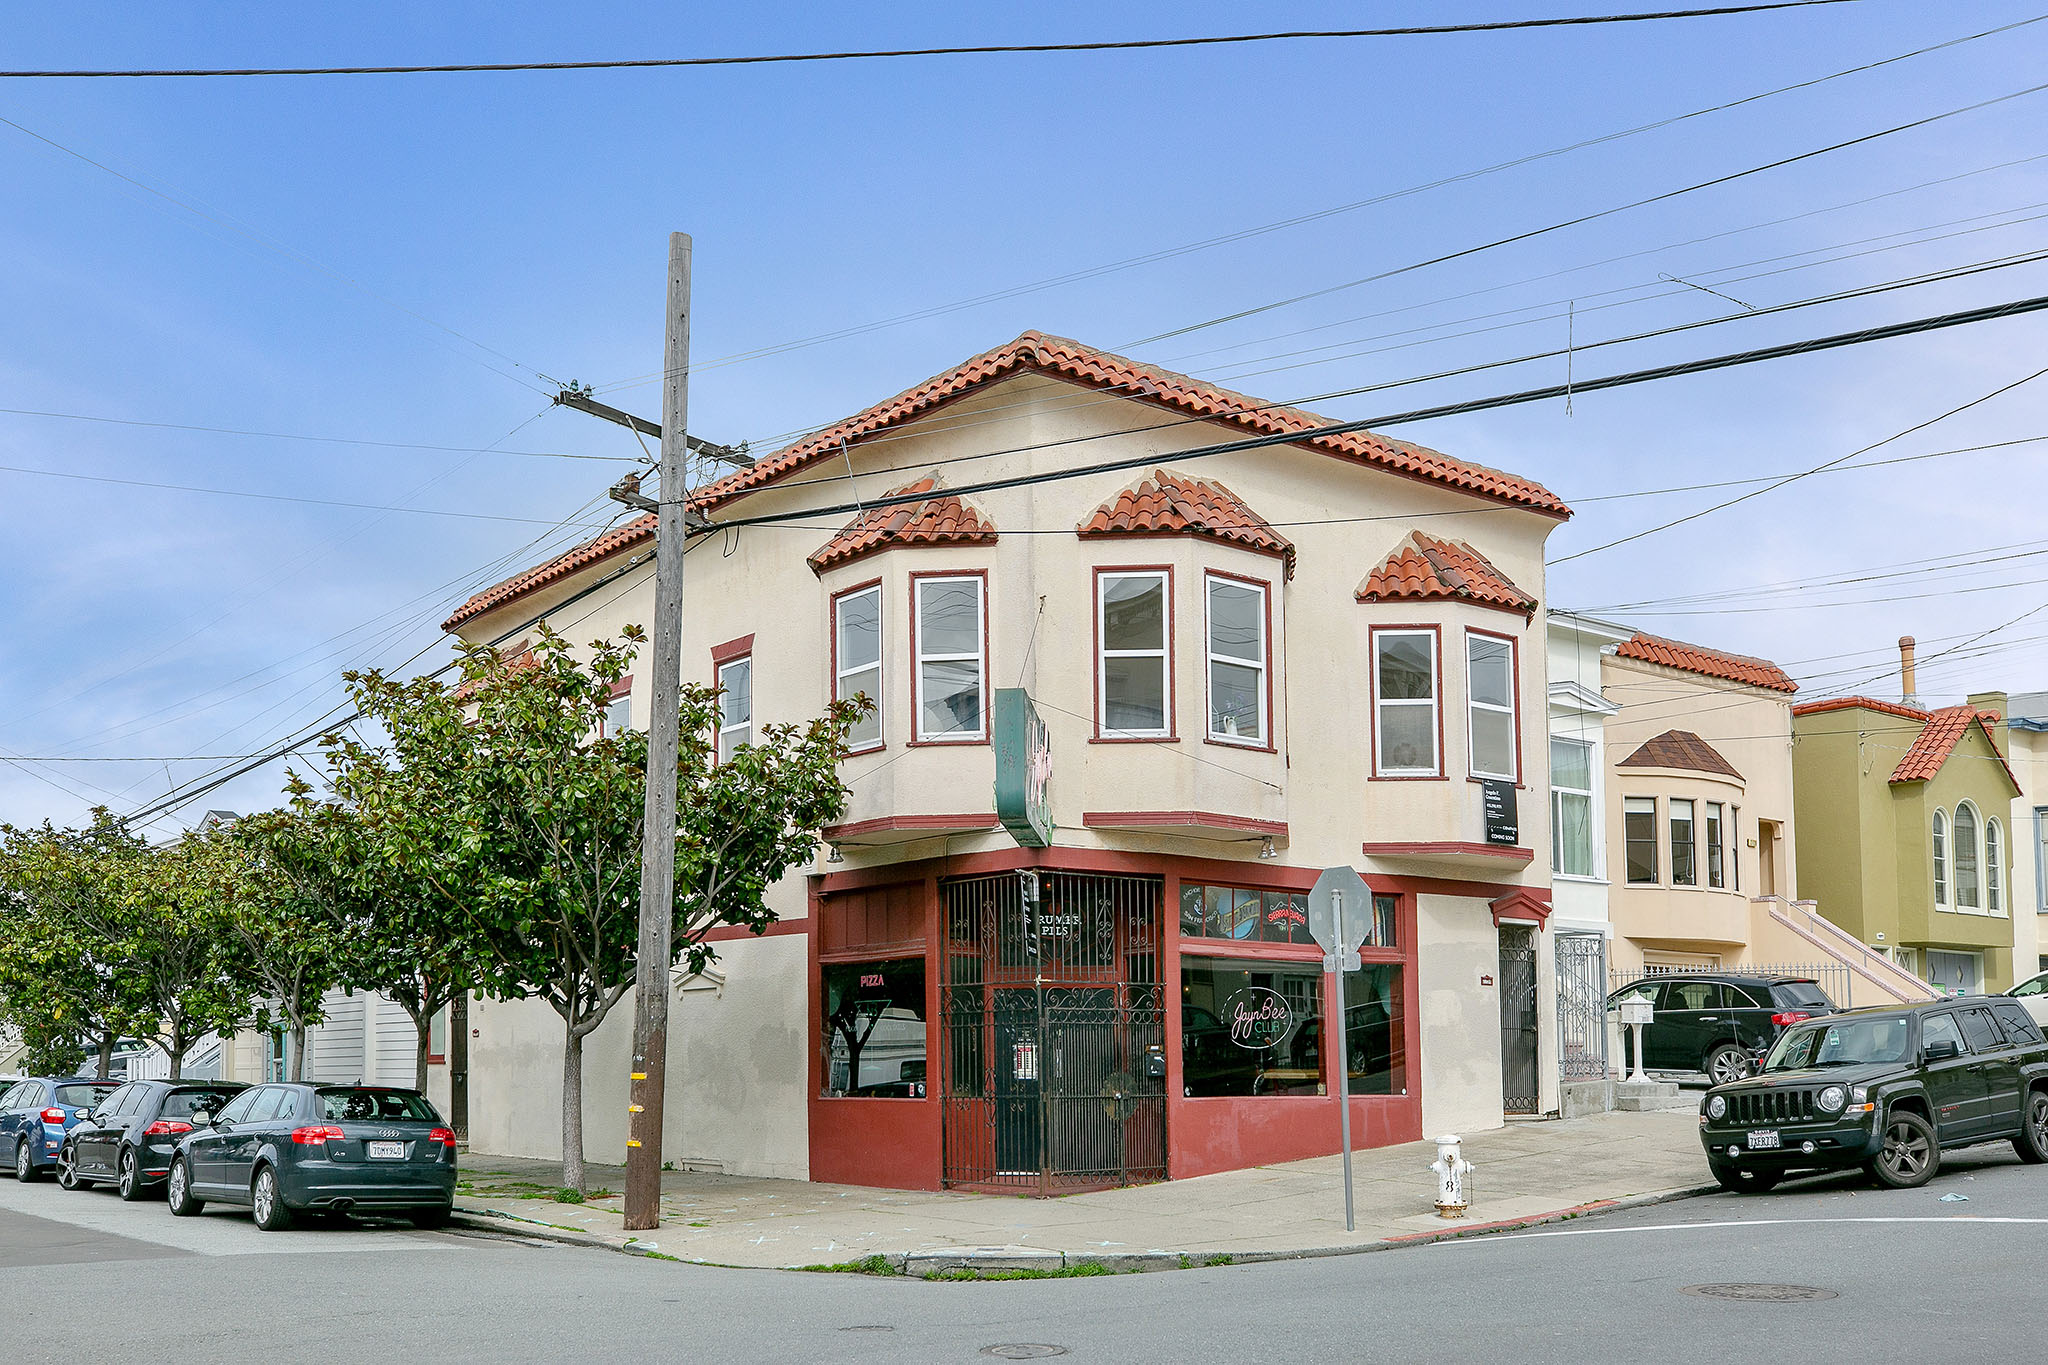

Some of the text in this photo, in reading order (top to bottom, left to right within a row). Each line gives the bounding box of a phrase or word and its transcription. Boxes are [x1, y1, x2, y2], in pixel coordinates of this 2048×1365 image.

[1038, 915, 1082, 925] RUMER
[1184, 910, 1194, 921] SAN
[1041, 926, 1069, 936] PILS
[860, 974, 884, 987] PIZZA
[1254, 1020, 1280, 1033] CLUB
